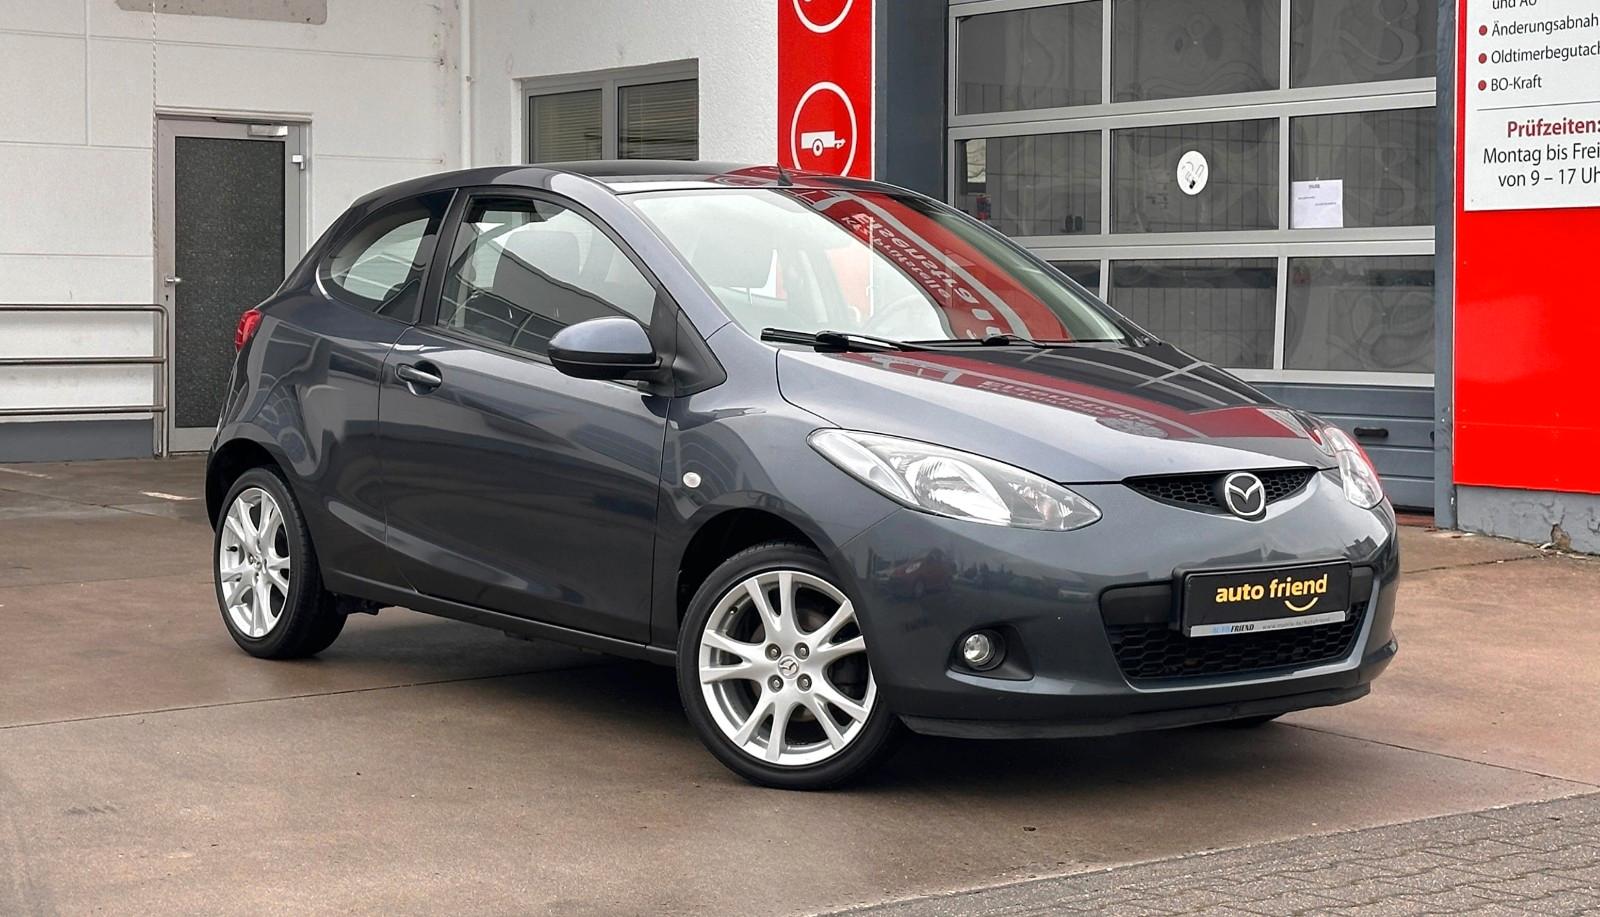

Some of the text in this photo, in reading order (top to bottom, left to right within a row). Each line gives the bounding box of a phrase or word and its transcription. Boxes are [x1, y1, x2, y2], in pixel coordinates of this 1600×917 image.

[1491, 74, 1542, 92] BO-Kraft
[1483, 147, 1542, 166] Montag
[1546, 144, 1568, 161] bis
[1498, 174, 1526, 187] von
[1530, 170, 1540, 186] 9
[1559, 168, 1576, 184] 17
[1215, 573, 1328, 603] auto friend
